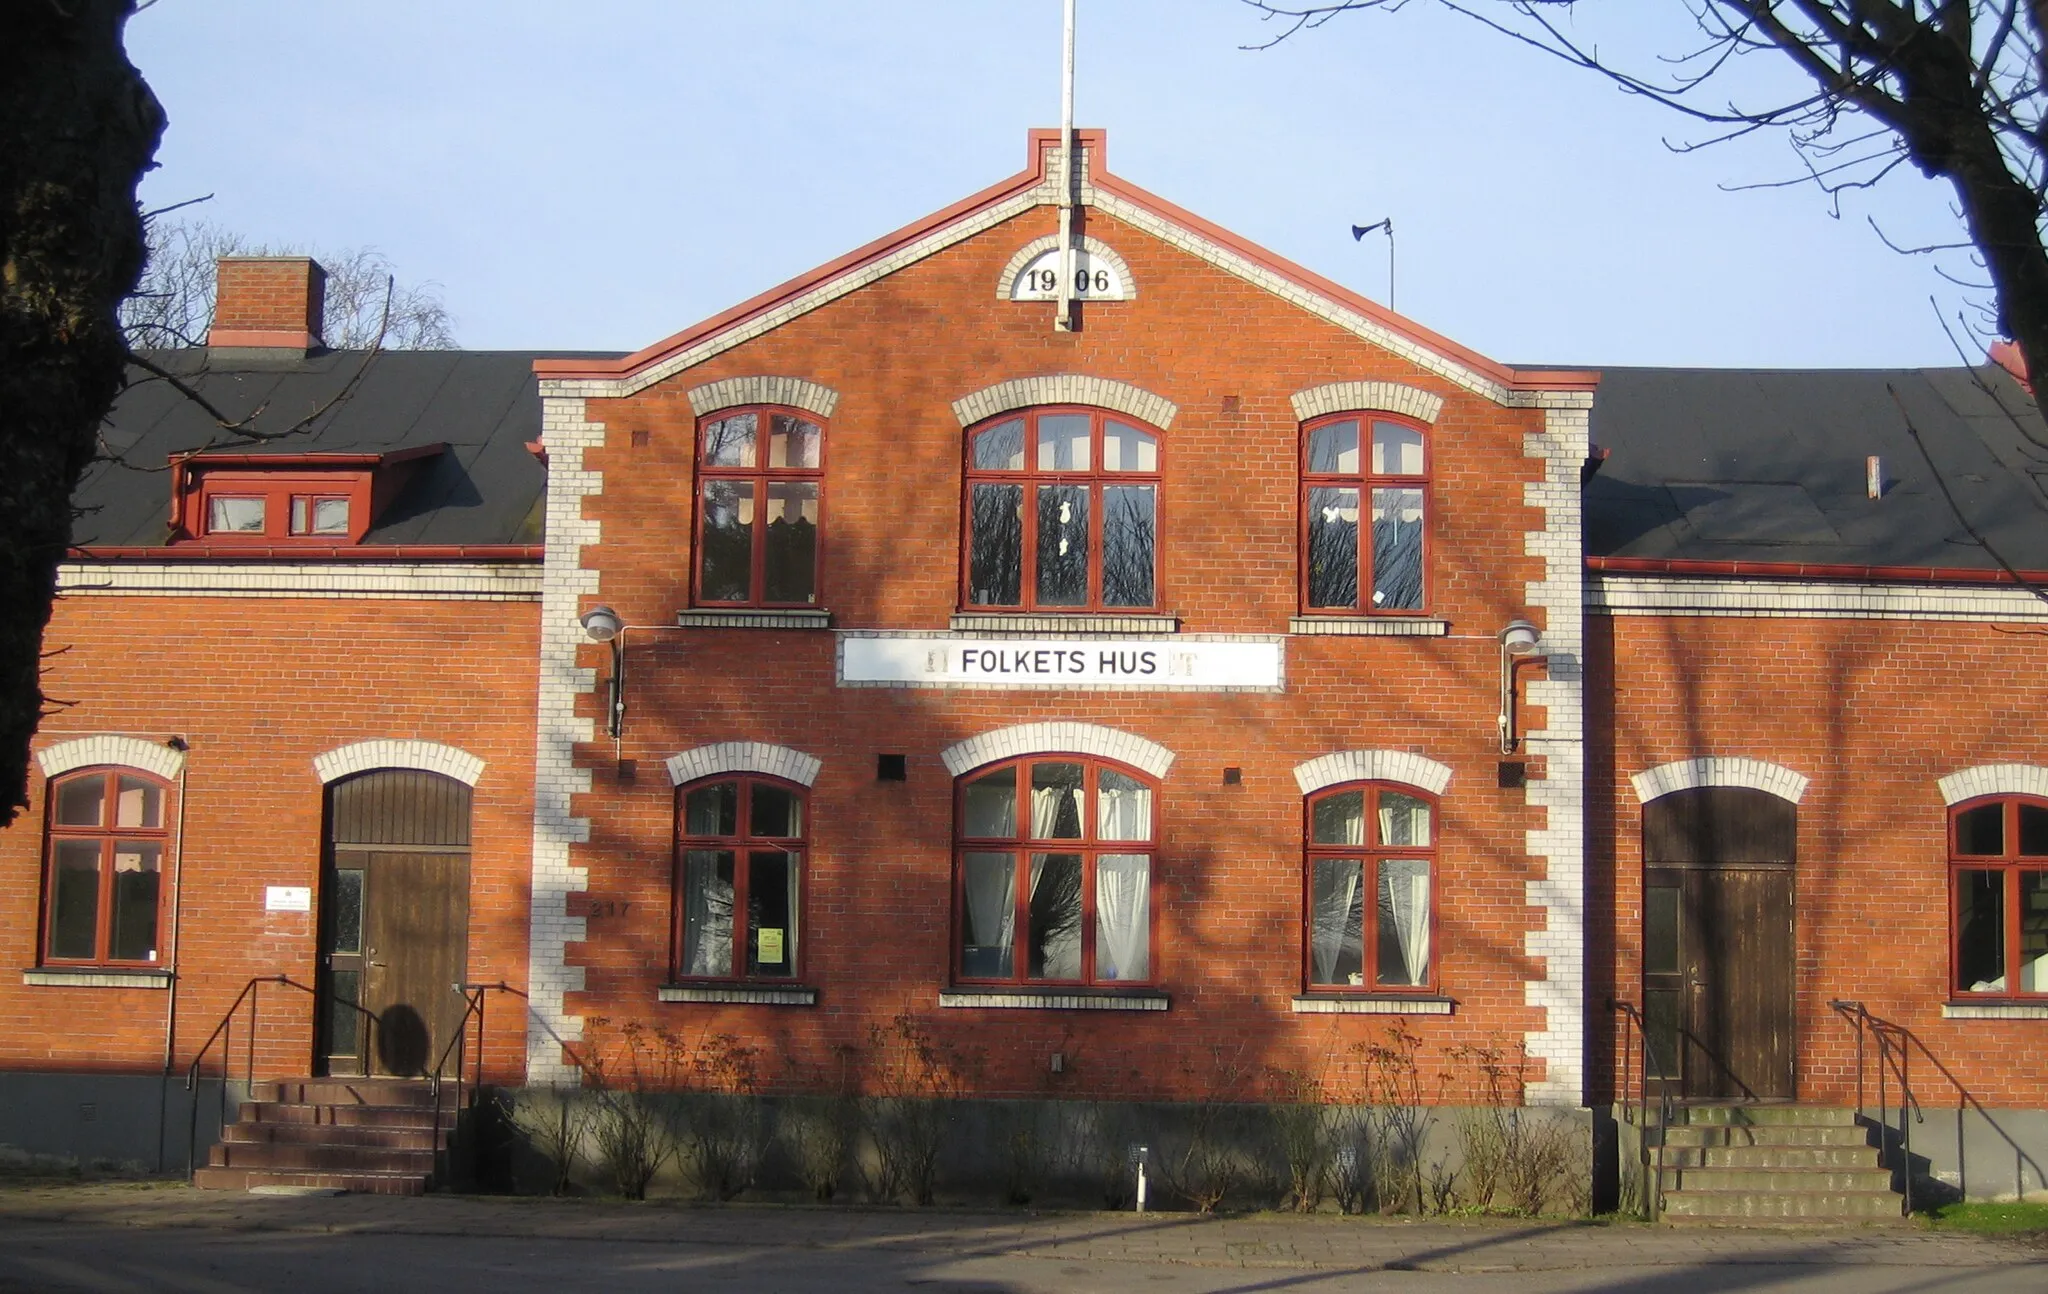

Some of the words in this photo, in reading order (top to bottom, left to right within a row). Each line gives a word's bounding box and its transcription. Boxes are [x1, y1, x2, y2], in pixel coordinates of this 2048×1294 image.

[962, 649, 1085, 674] FOLKETS
[1099, 651, 1156, 675] HUS
[591, 901, 630, 917] 217
